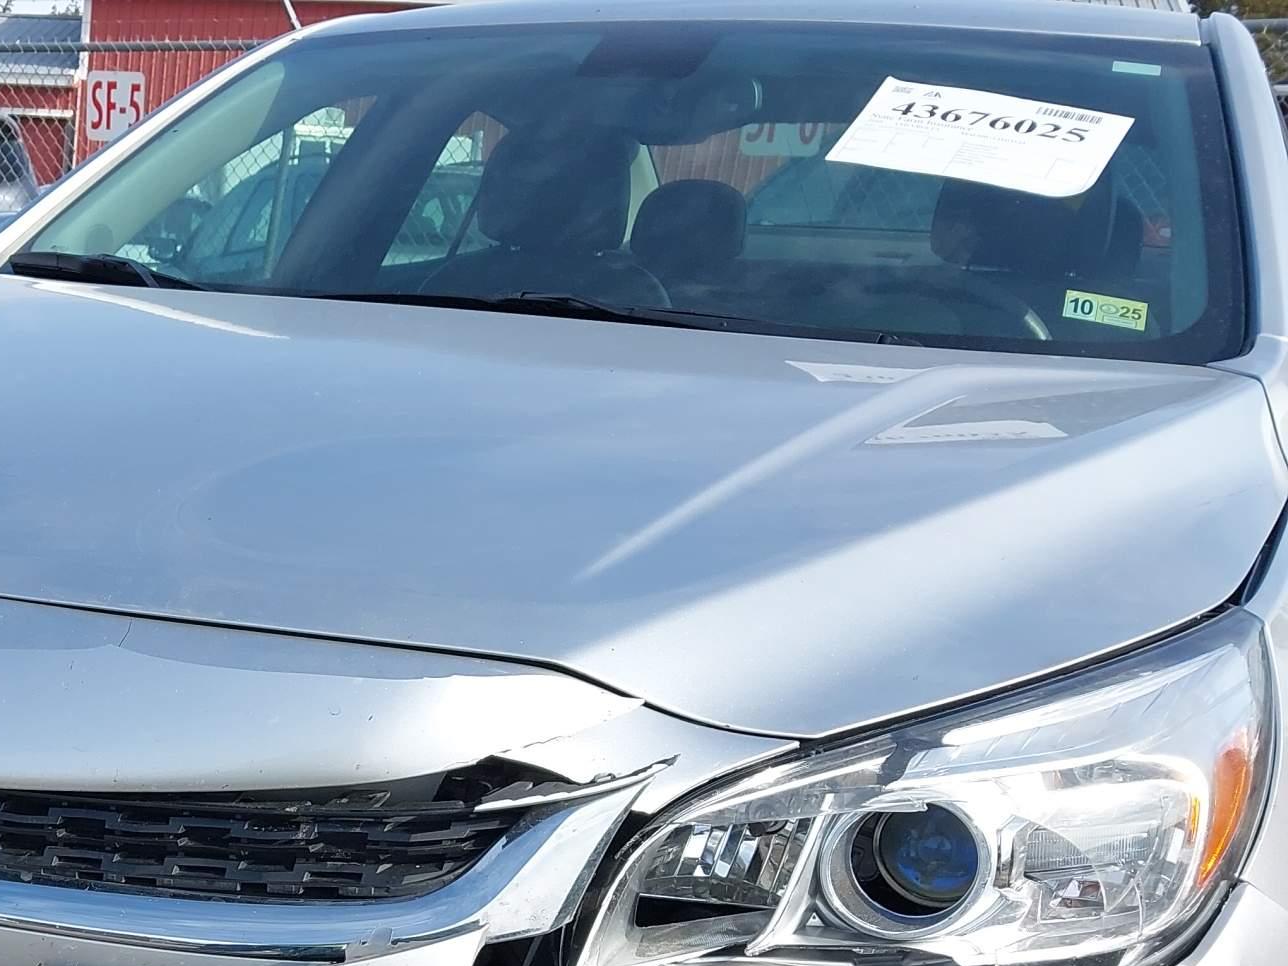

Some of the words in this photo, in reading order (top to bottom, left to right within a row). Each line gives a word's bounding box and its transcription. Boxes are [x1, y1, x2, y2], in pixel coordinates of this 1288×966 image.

[91, 81, 141, 130] SF-5
[892, 102, 1089, 143] 43676025
[1069, 298, 1093, 315] 10
[1119, 306, 1142, 320] 25
